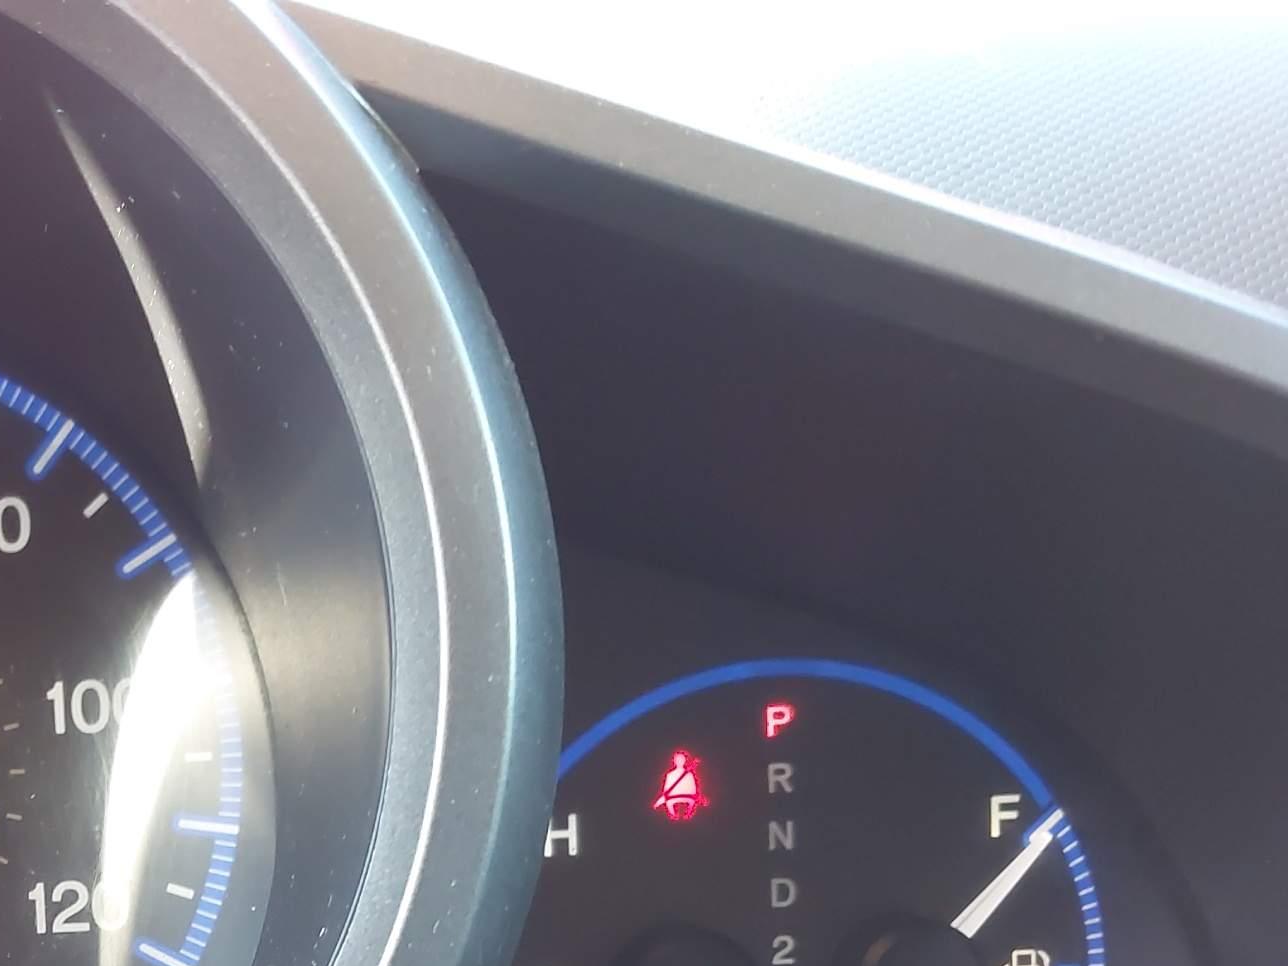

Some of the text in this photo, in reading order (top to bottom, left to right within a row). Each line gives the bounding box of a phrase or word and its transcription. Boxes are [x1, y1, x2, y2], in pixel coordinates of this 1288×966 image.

[765, 704, 794, 738] P
[767, 762, 794, 794] R
[989, 793, 1021, 838] F
[544, 812, 578, 858] H
[768, 820, 795, 851] N
[28, 880, 129, 934] 120
[771, 877, 797, 908] D
[771, 935, 796, 965] 2
